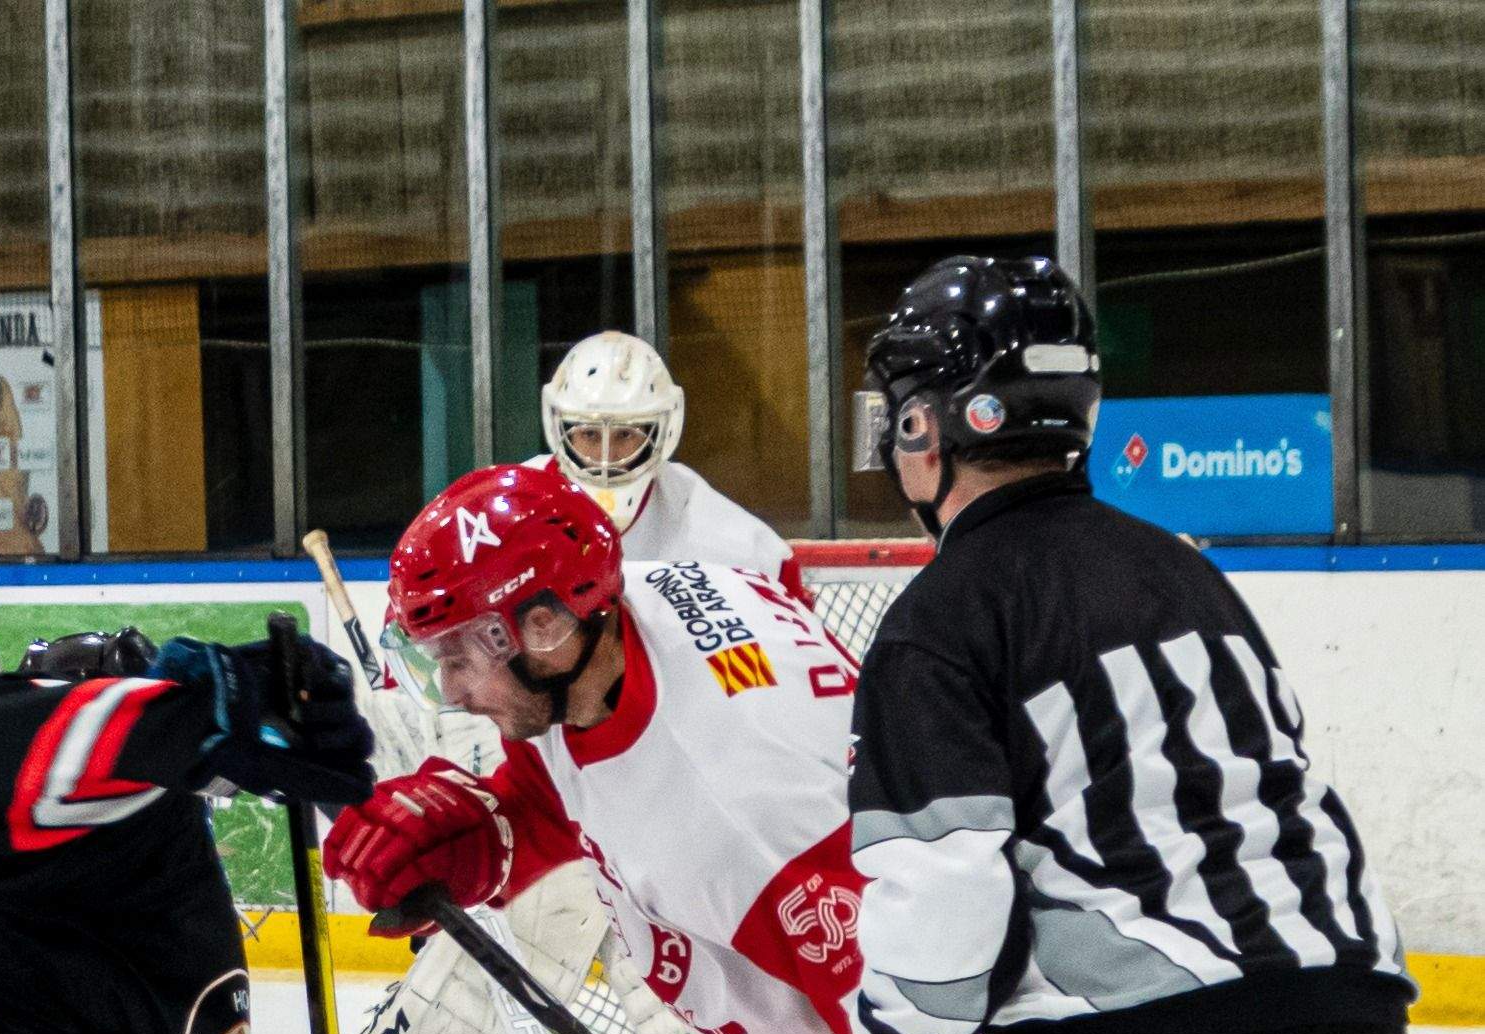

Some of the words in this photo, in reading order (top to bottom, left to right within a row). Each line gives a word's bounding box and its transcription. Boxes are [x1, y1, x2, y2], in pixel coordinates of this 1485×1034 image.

[1162, 438, 1303, 478] Domino's
[456, 507, 501, 563] A
[488, 566, 535, 603] CCM
[645, 568, 722, 652] GOBIERNO
[716, 617, 755, 643] DE
